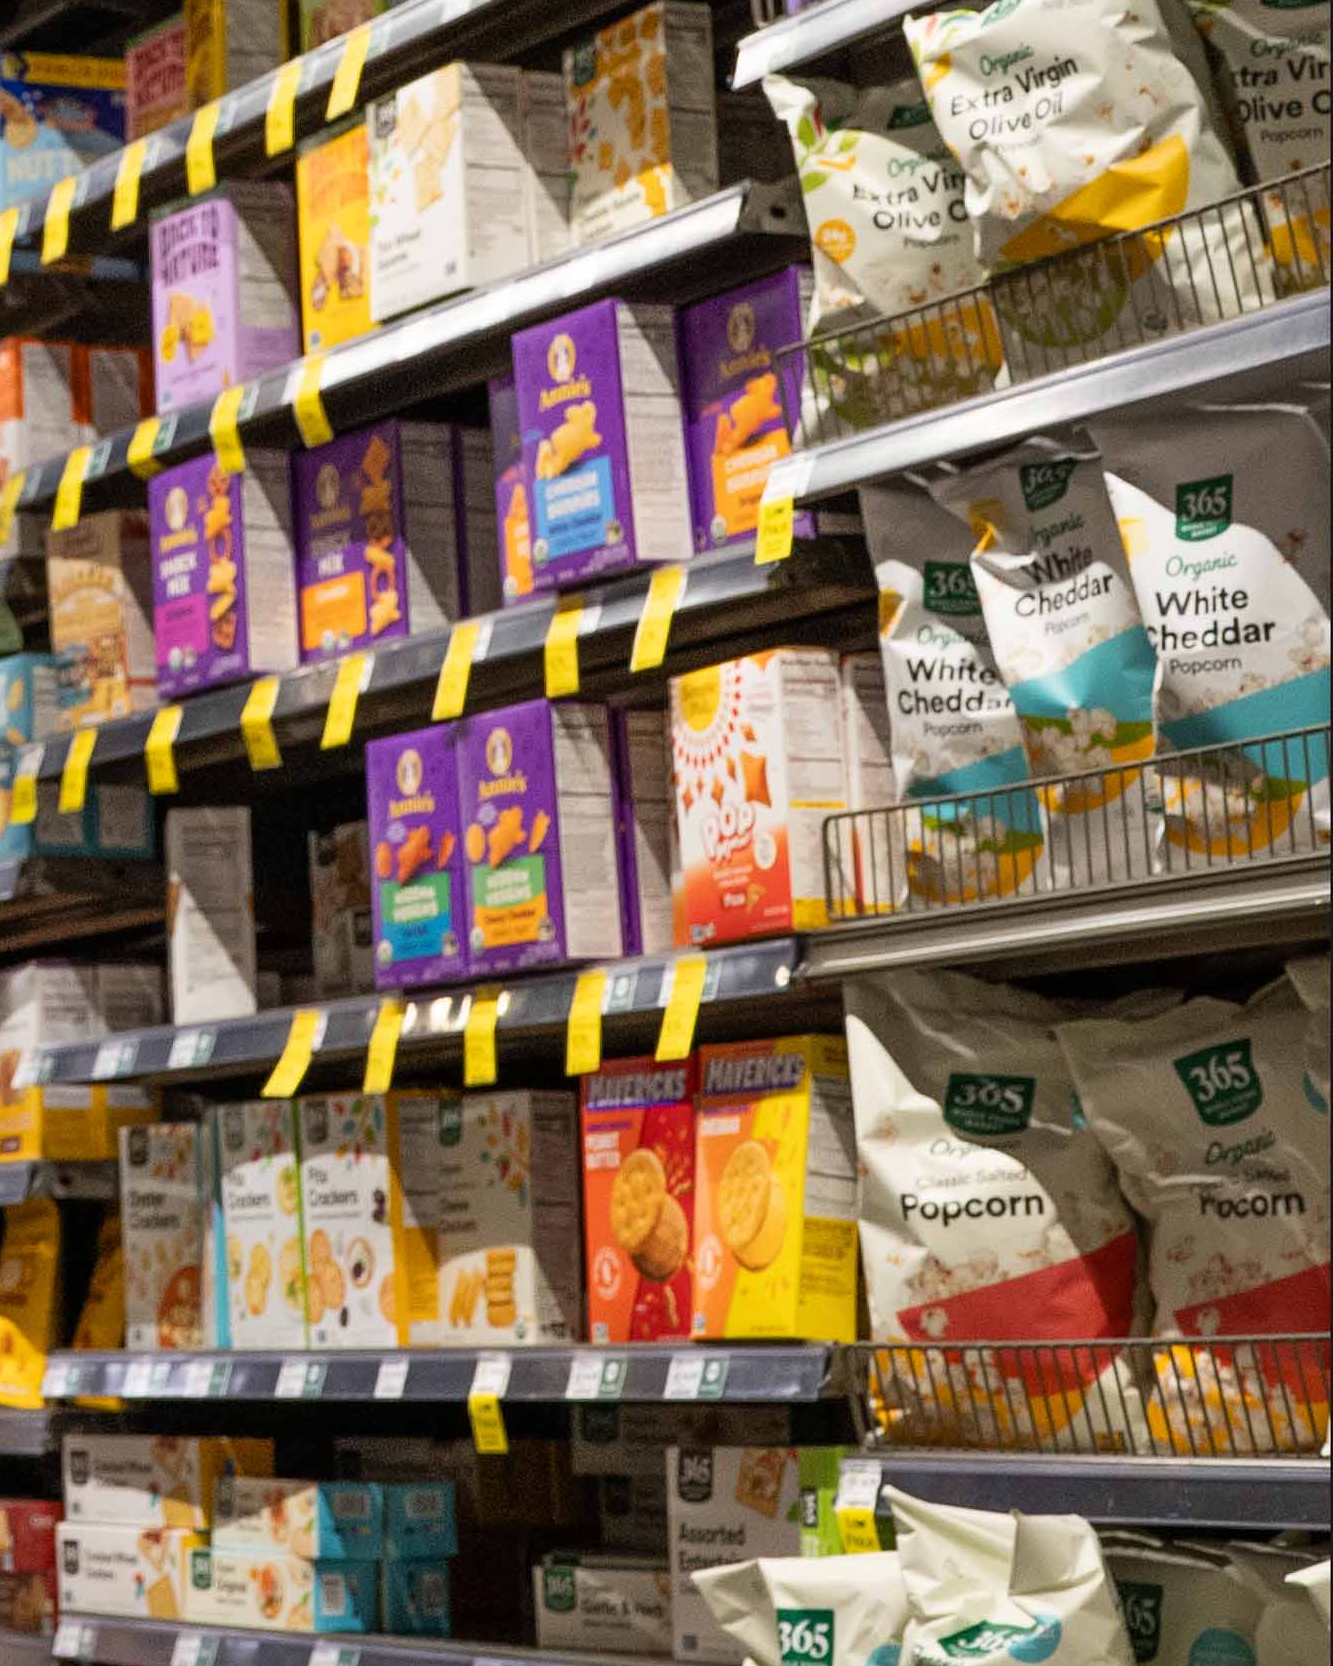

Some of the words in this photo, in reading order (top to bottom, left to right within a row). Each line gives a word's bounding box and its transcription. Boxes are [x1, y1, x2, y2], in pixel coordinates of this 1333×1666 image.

[950, 85, 1014, 118] Extra
[1020, 54, 1079, 98] Virgin
[1286, 53, 1330, 86] Vir
[968, 110, 1033, 142] Olive
[1035, 93, 1064, 123] Oil
[925, 166, 967, 197] Vir
[872, 203, 942, 232] Olive
[1180, 485, 1227, 521] 365
[1020, 544, 1095, 586] White
[1165, 551, 1239, 582] Organic
[1013, 572, 1114, 618] Cheddar
[1155, 586, 1250, 618] White
[905, 656, 997, 685] White
[1169, 656, 1244, 677] Popcorn
[588, 1069, 687, 1103] MAVERICKS
[705, 1053, 806, 1091] MAVERICKS
[1189, 1051, 1253, 1104] 365
[953, 1080, 1026, 1115] 365
[900, 1192, 1045, 1227] Popcorn
[678, 1524, 746, 1546] Assorted
[1126, 1597, 1156, 1636] 65
[778, 1618, 831, 1659] 365
